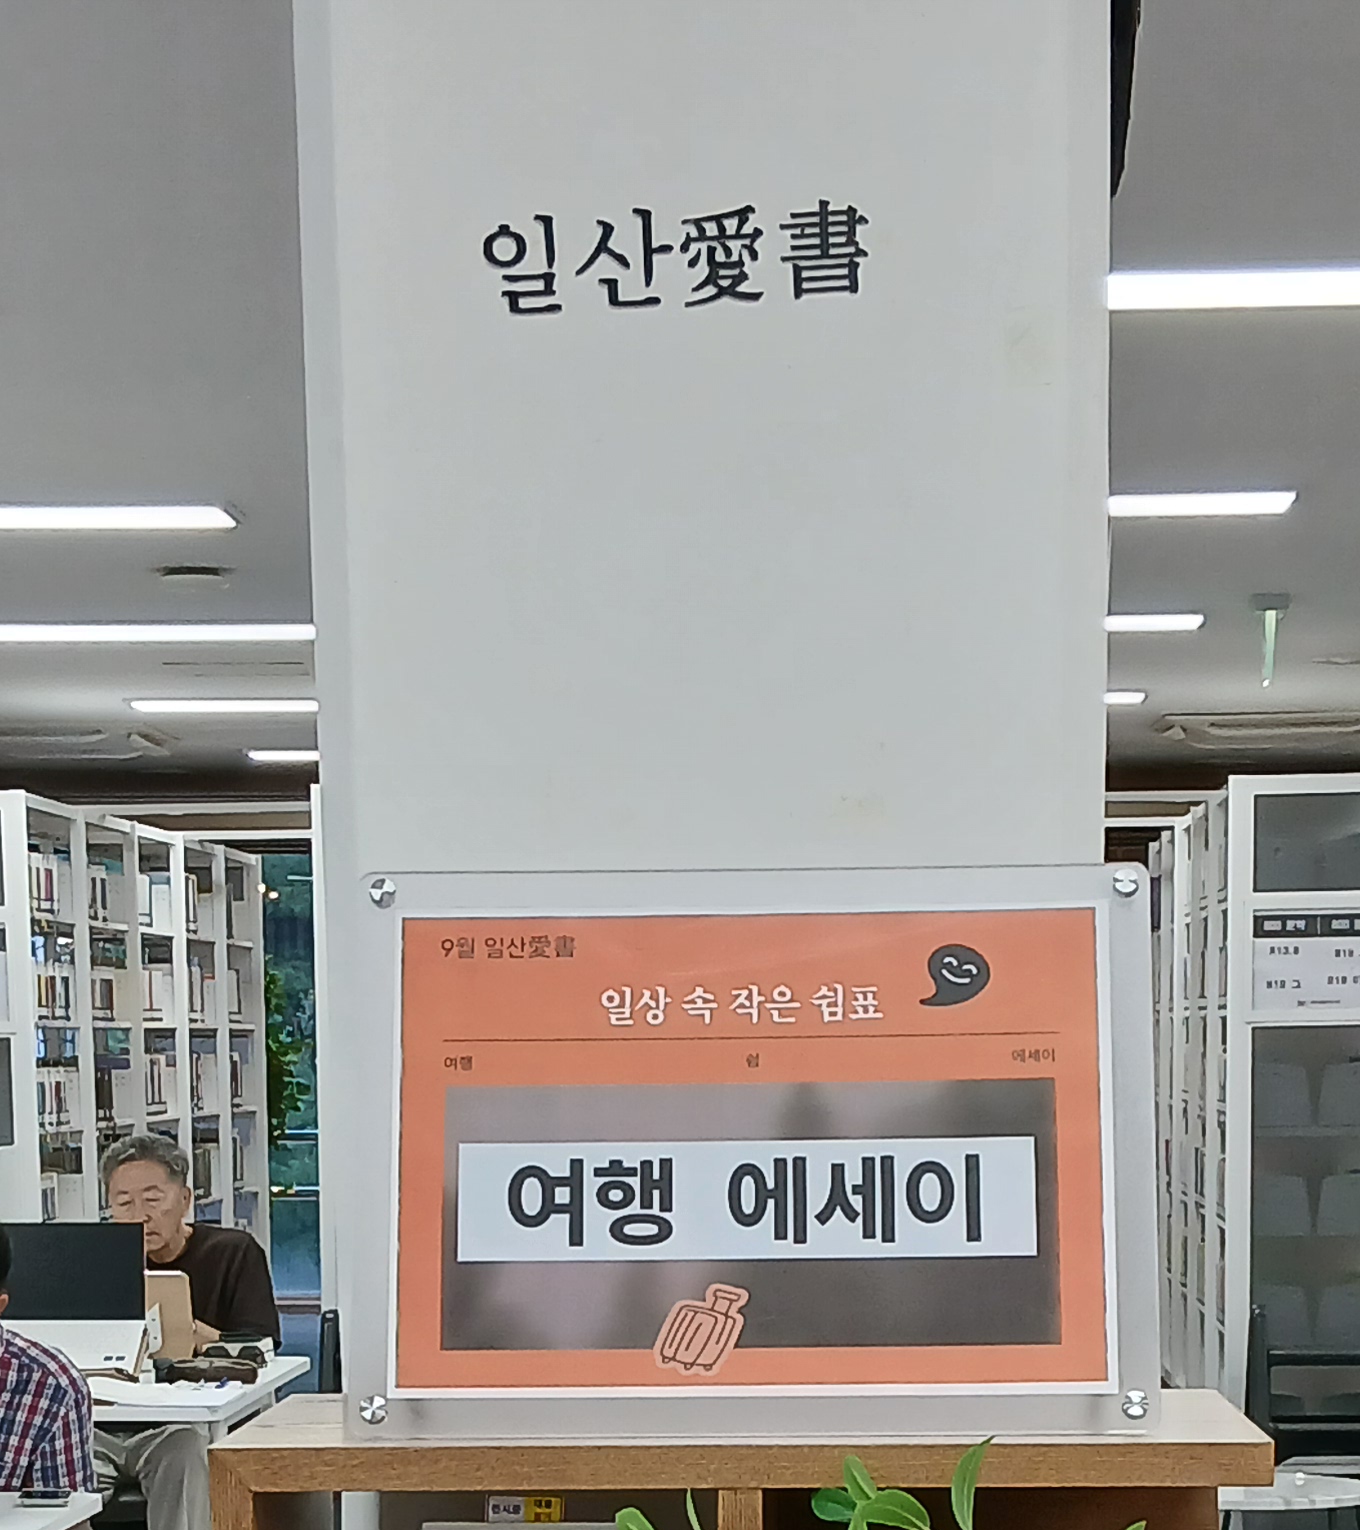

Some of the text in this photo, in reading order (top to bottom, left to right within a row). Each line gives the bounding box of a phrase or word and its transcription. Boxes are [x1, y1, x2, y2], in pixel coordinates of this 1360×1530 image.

[482, 199, 869, 315] 일산愛書
[441, 934, 577, 961] 9월 일산愛書
[599, 983, 883, 1027] 일상 속 작은 쉼표
[443, 1054, 473, 1072] 여행
[1011, 1047, 1057, 1065] 에세이
[508, 1152, 981, 1248] 여행 에세이
